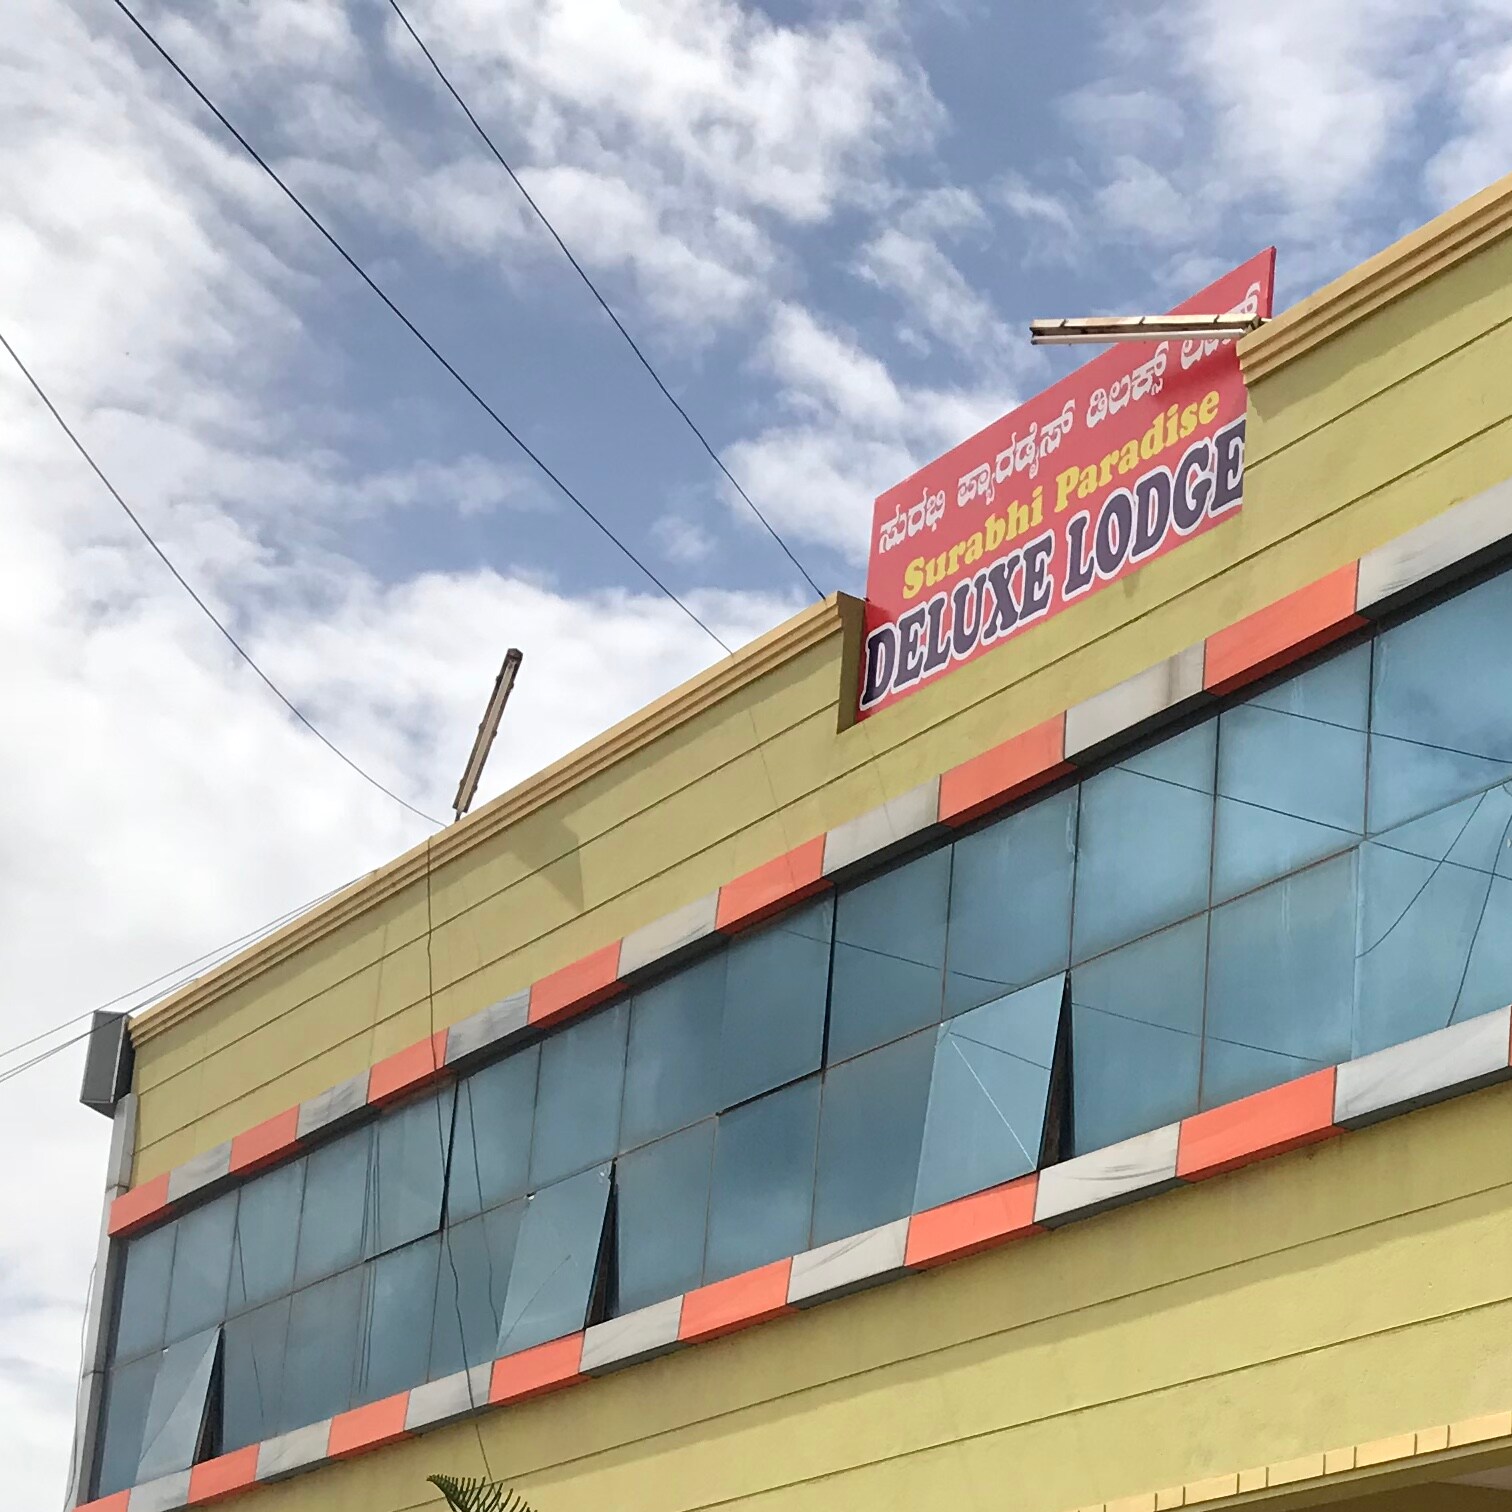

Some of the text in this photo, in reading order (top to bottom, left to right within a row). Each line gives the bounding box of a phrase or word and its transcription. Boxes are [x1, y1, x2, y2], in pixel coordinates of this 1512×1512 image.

[860, 418, 1245, 710] DELUXE LODGE
[879, 488, 946, 554] ಸುರಭಿ
[902, 389, 1220, 600] Surabhi Paradise
